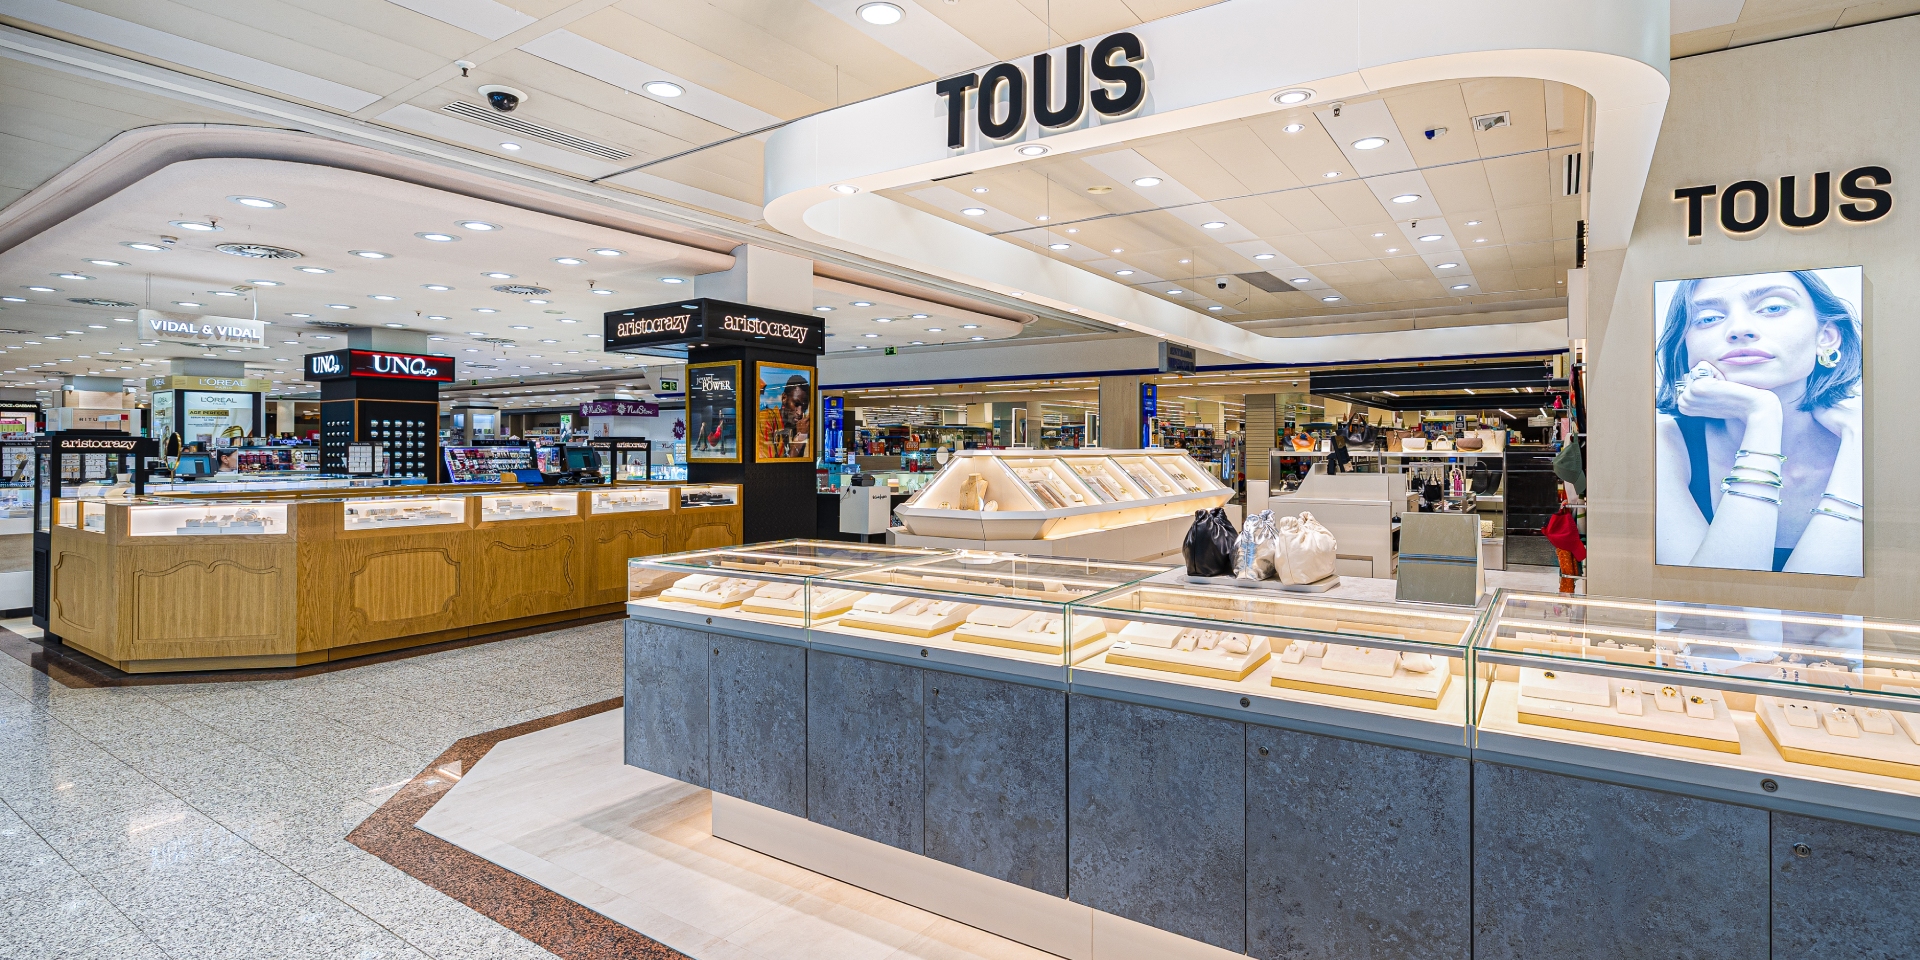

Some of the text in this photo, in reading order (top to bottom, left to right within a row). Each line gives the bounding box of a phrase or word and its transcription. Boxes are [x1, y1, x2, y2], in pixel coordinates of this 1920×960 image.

[936, 32, 1145, 149] TOUS
[1674, 165, 1893, 238] TOUS
[149, 319, 261, 339] VIDAL & VIDAL
[617, 314, 691, 338] aristocrazy
[724, 315, 809, 344] aristocrazy
[702, 380, 734, 391] POWER
[61, 439, 138, 450] aristocrazy
